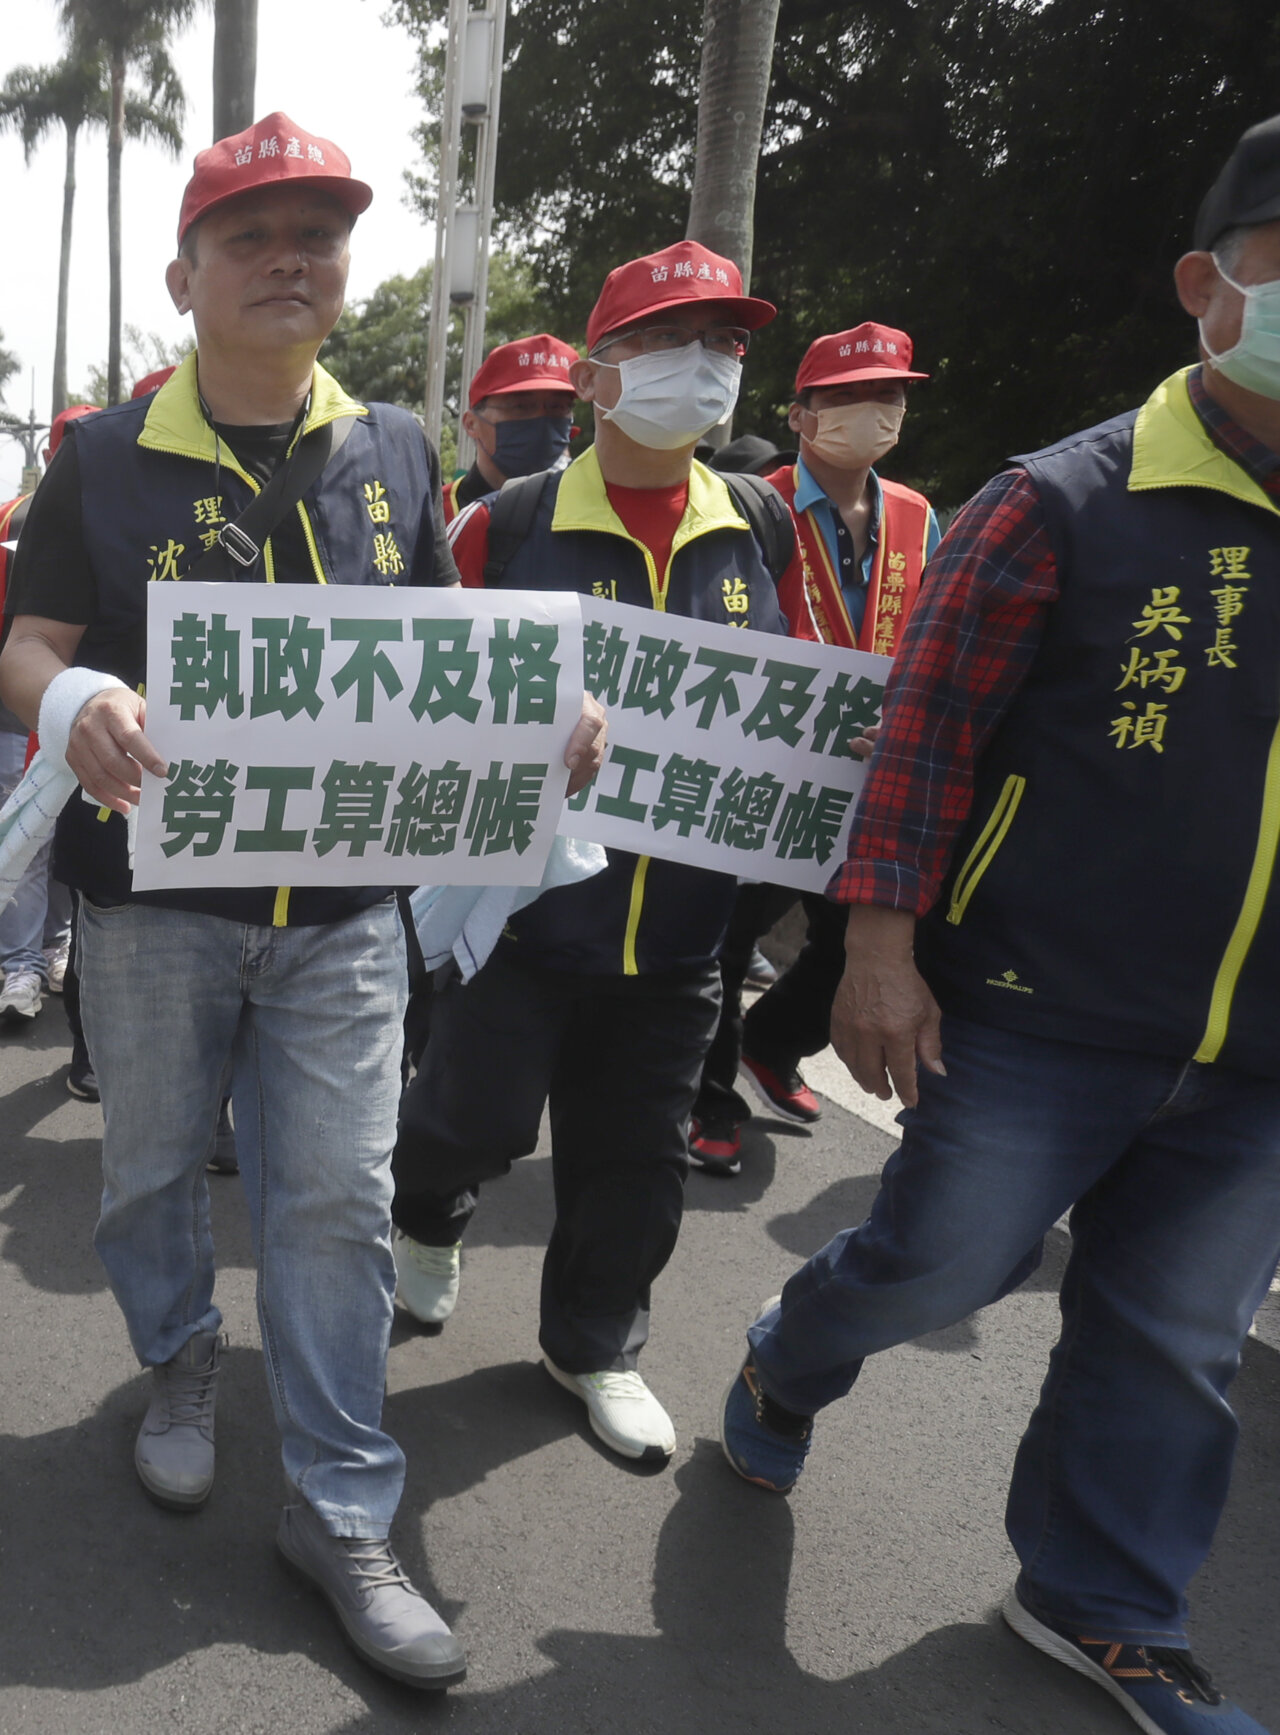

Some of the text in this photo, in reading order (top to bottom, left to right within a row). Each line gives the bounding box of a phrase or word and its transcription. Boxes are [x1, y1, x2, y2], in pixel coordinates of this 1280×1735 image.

[234, 136, 325, 166] 苗縣產總
[650, 260, 730, 288] 苗縣產總
[1203, 545, 1253, 669] 理事長
[169, 612, 562, 725] 執政不及格
[583, 620, 886, 763] 執政不及格
[1107, 585, 1192, 754] 吳炳禎
[160, 759, 550, 858] 勞工算總帳
